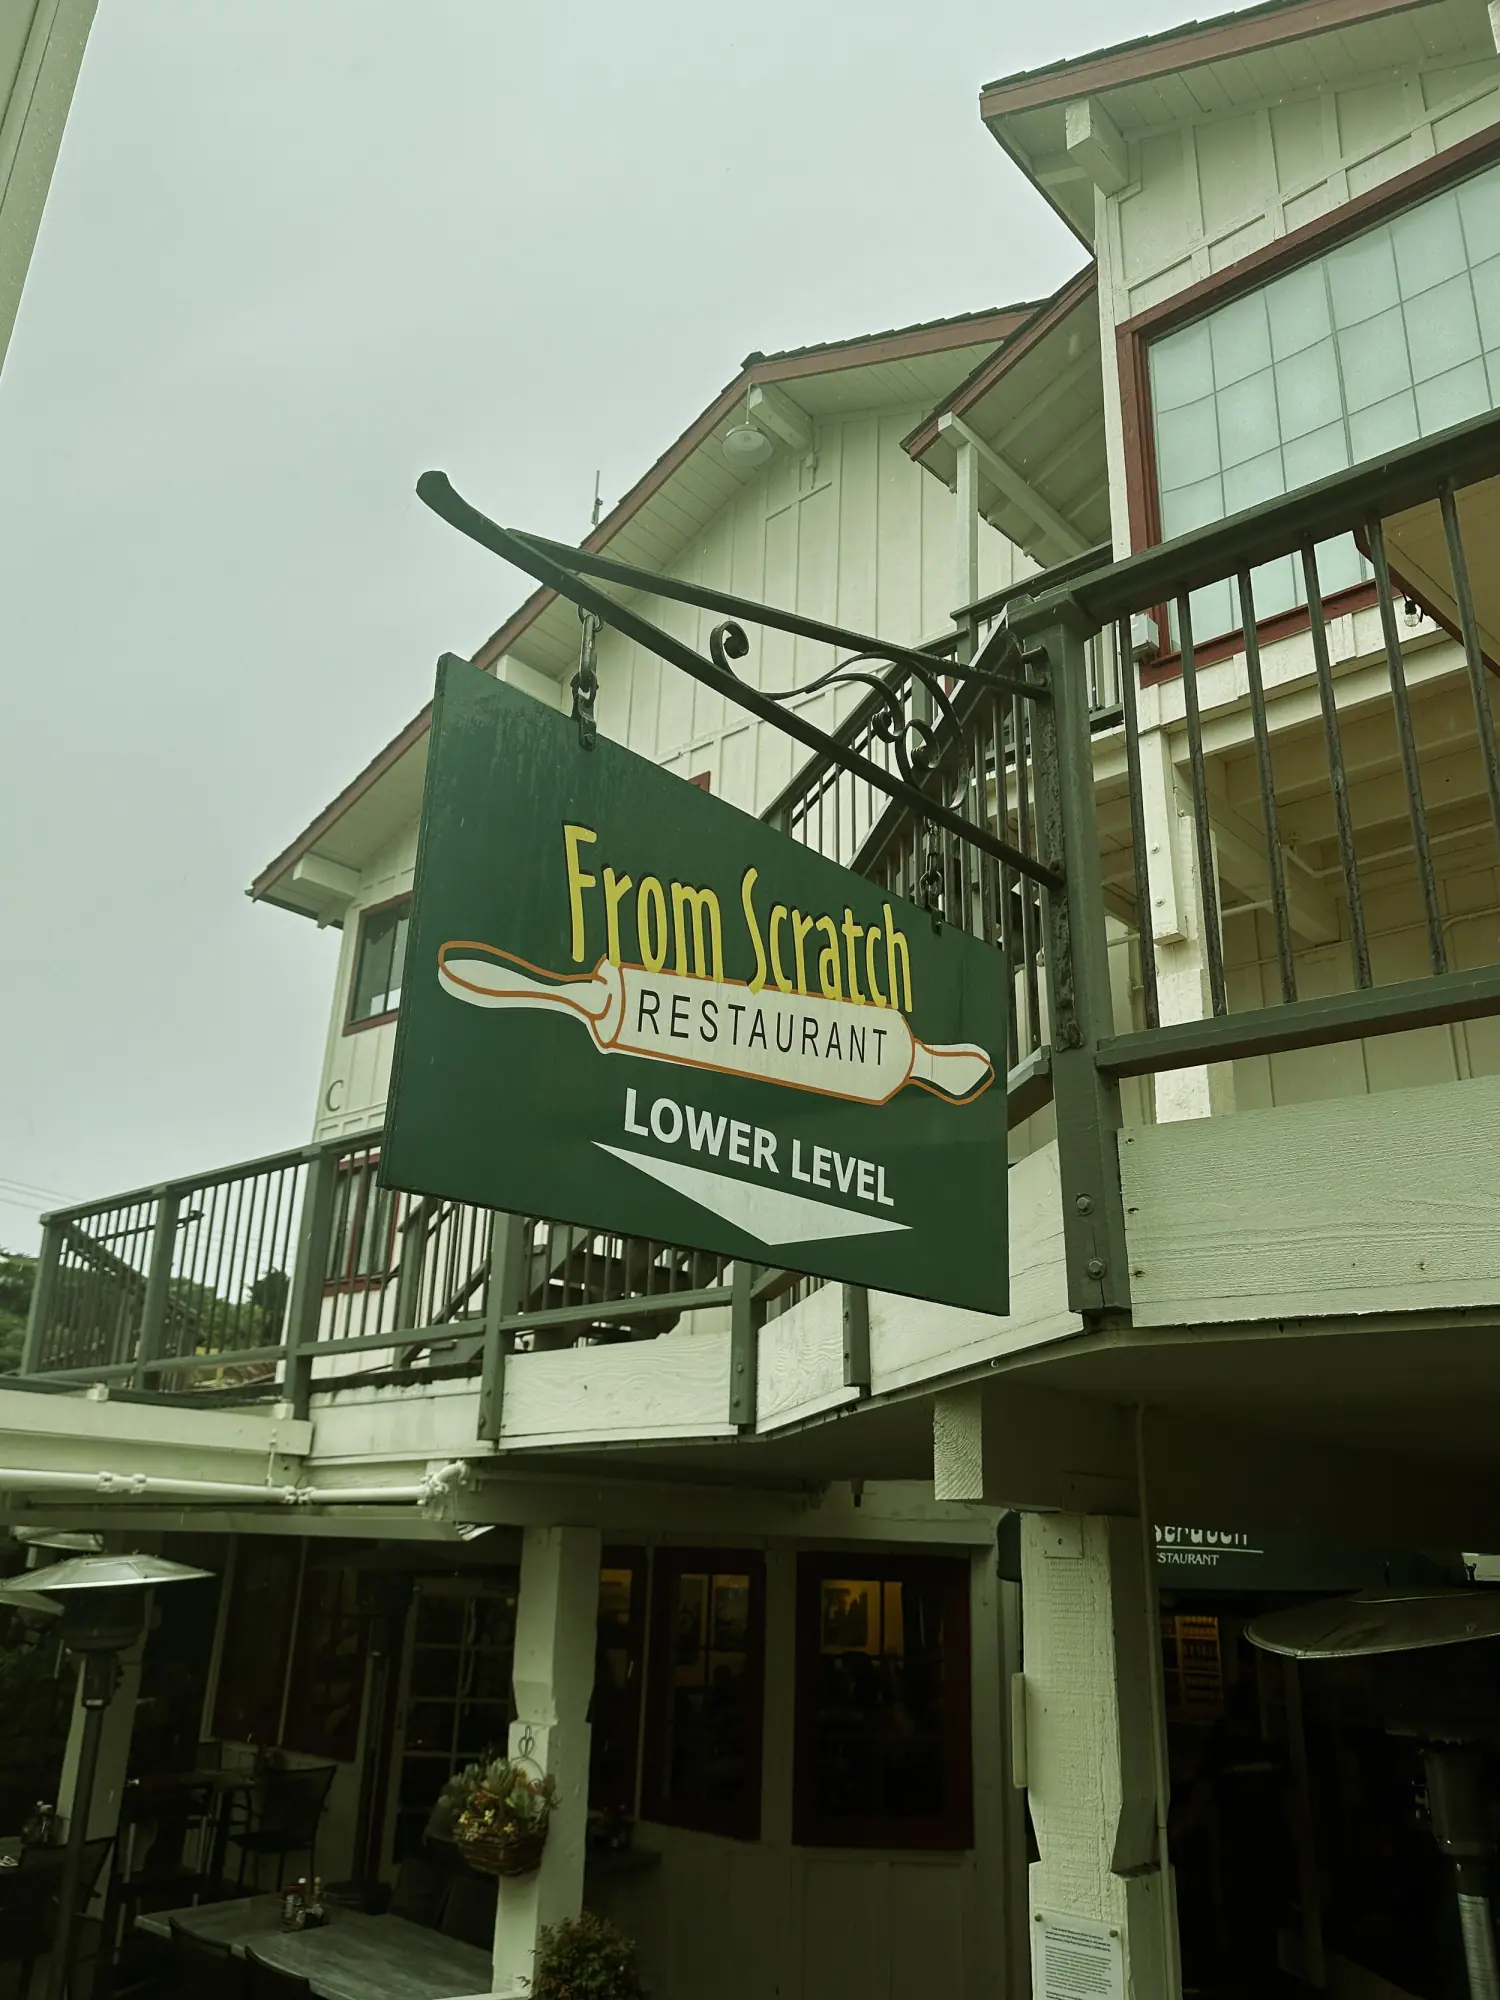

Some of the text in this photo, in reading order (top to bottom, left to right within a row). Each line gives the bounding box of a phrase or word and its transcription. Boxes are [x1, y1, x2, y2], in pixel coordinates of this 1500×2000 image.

[564, 824, 913, 1012] From Scratch
[636, 989, 888, 1066] RESTAURANT
[623, 1087, 895, 1206] LOWER LEVEL
[1156, 1552, 1220, 1566] STAURANT
